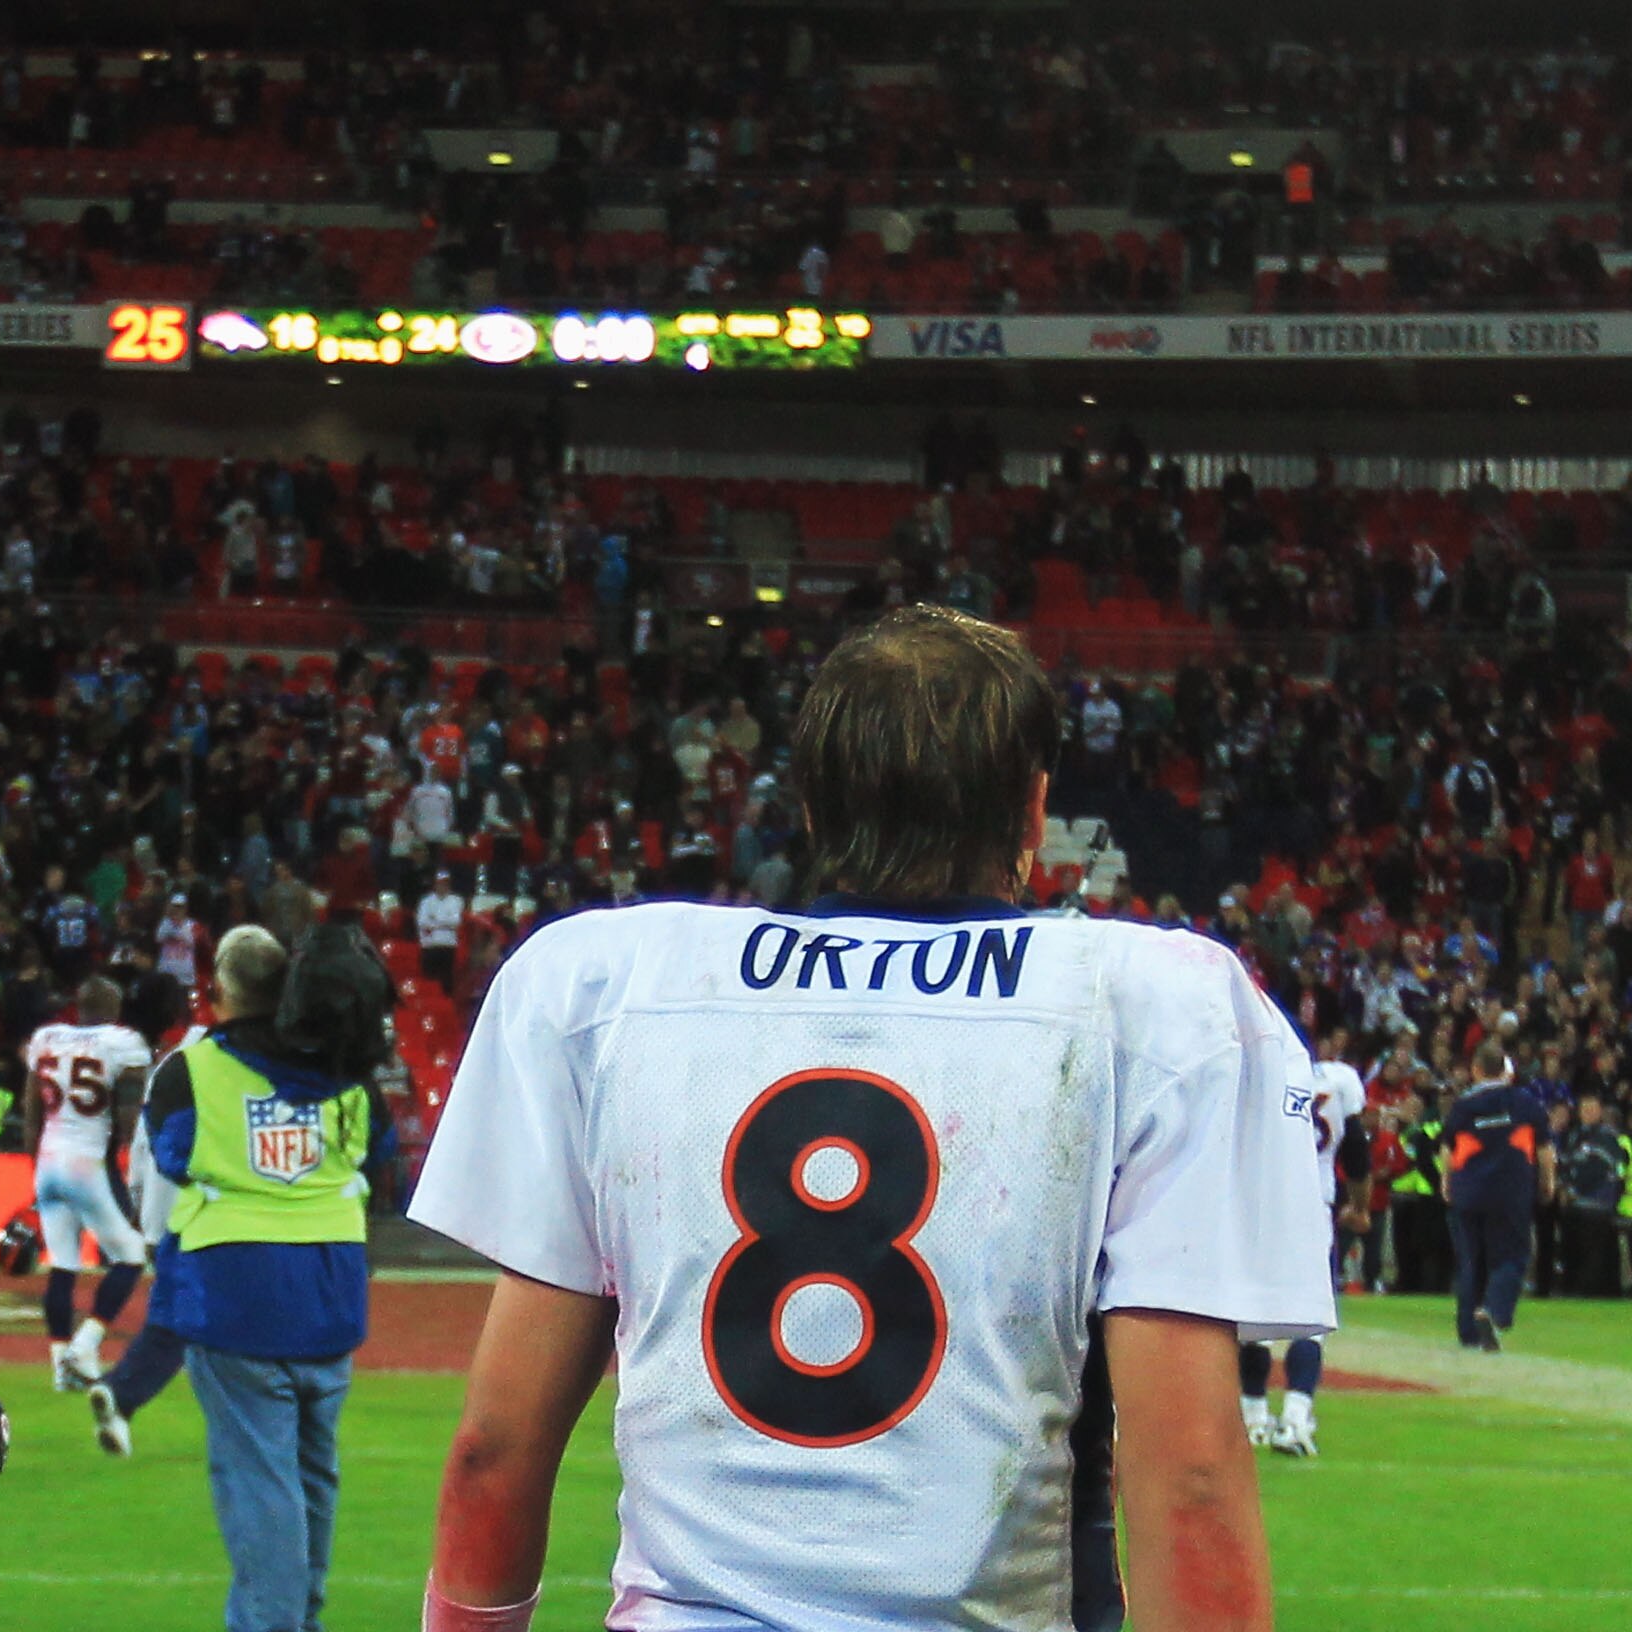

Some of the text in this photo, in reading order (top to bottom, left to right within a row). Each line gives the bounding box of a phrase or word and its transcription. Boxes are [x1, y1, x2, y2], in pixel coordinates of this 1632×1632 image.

[108, 304, 187, 361] 25
[405, 314, 457, 353] 24
[909, 320, 1006, 358] VISA
[1229, 323, 1600, 353] NFL INTERNATIONAL SERIES
[740, 922, 1034, 998] ORTON
[257, 1129, 319, 1172] NFL
[701, 1067, 948, 1449] 8
